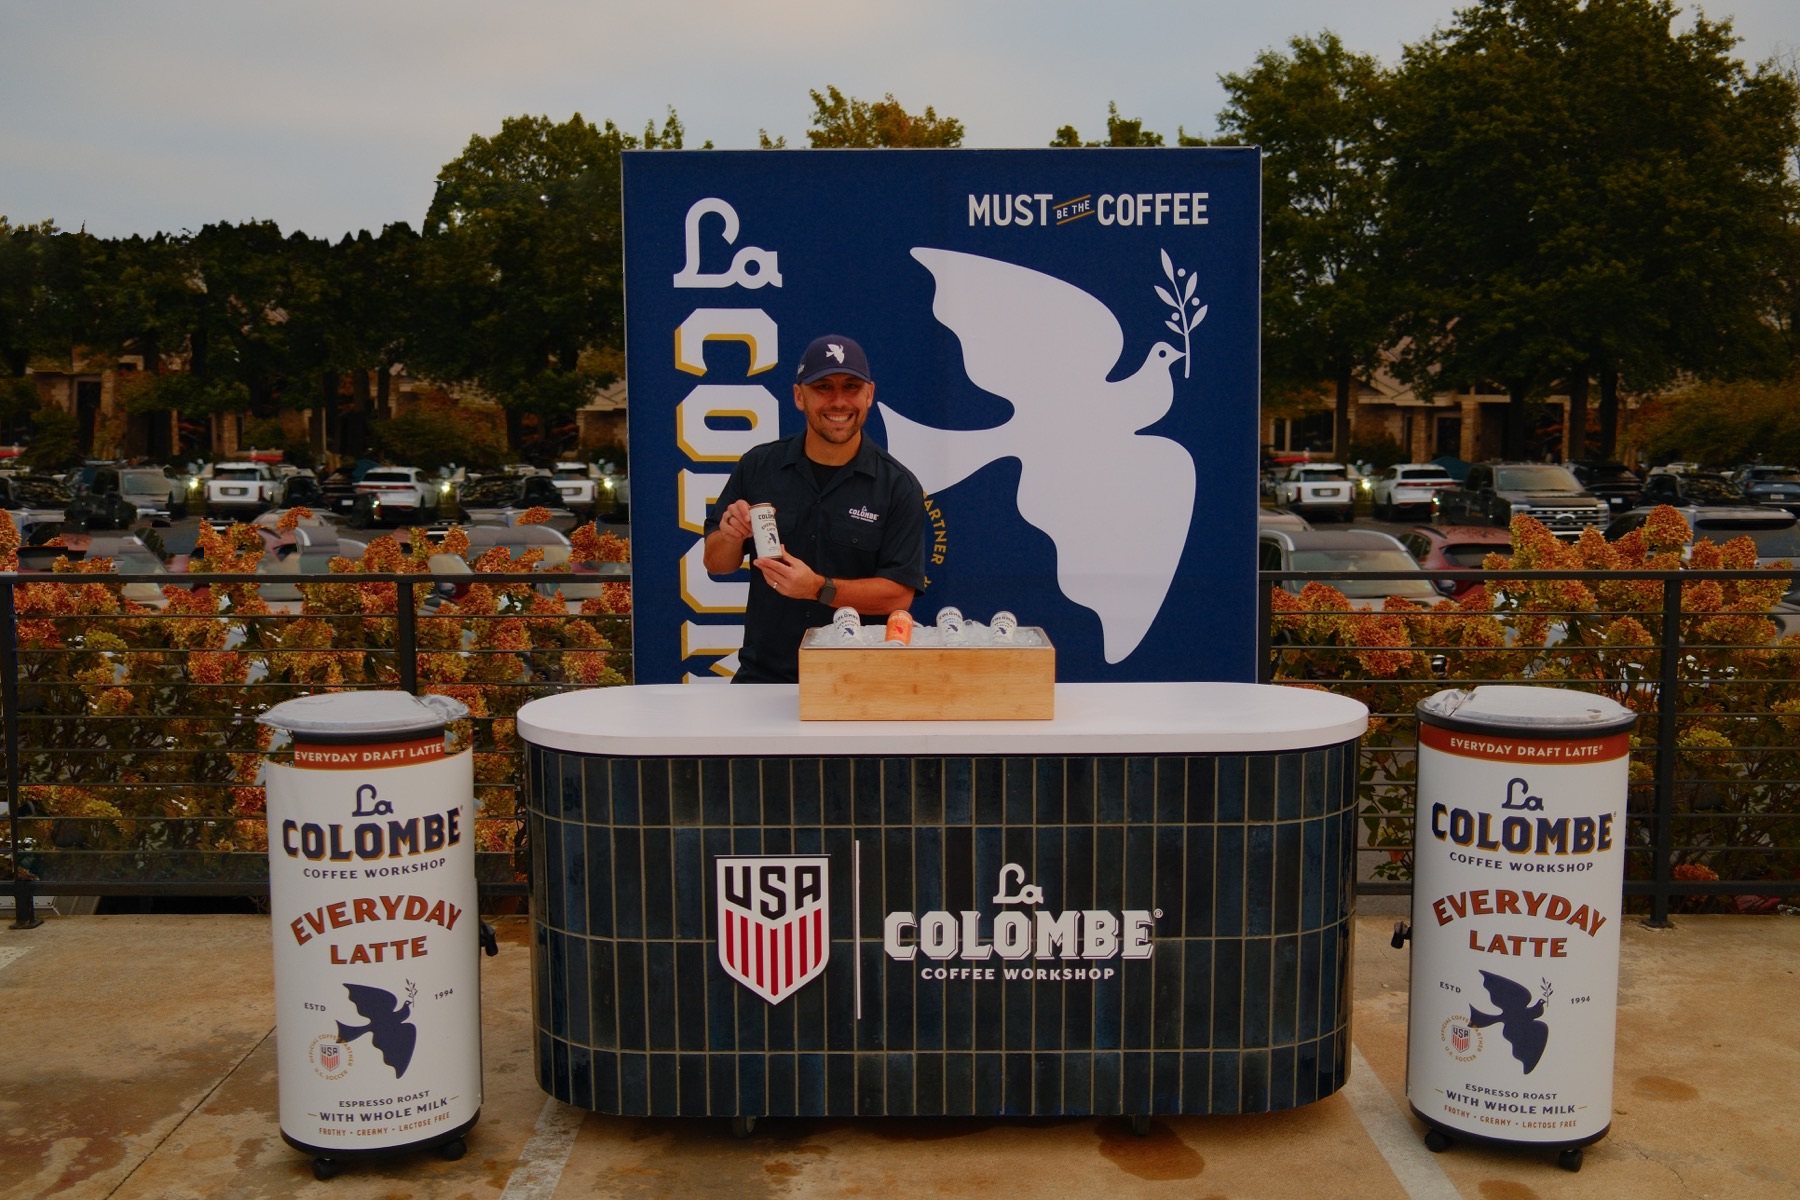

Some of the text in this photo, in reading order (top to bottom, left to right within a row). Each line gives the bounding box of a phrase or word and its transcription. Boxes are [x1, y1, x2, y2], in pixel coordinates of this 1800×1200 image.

[968, 192, 1209, 227] MUST BE THE COFFEE
[673, 197, 783, 290] La
[295, 751, 358, 763] EVERYDAY
[363, 749, 405, 762] DRAFT
[1450, 737, 1512, 755] EVERYDAY
[1517, 745, 1561, 757] DRAFT
[352, 784, 394, 817] La
[1501, 777, 1544, 812] La
[303, 857, 446, 880] COFFEE WORKSHOP
[1449, 851, 1594, 873] COFFEE WORKSHOP
[725, 865, 821, 921] USA
[993, 862, 1044, 905] La
[290, 894, 462, 946] EVERYDAY
[1432, 889, 1607, 937] EVERYDAY
[330, 935, 428, 965] LATTE
[1469, 929, 1568, 958] LATTE
[921, 968, 1115, 981] COFFEE WORKSHOP
[1439, 981, 1461, 993] ESTD
[434, 988, 454, 1000] 1994
[1570, 996, 1590, 1005] 1994
[304, 1002, 327, 1012] ESTD
[1453, 1027, 1469, 1039] USA
[321, 1046, 338, 1057] USA
[339, 1090, 430, 1108] ESPRESSO ROAST
[1446, 1089, 1576, 1115] WITH WHOLE MILK
[1465, 1083, 1557, 1100] ESPRESSO ROAST
[319, 1097, 448, 1122] WITH WHOLE MILK
[1444, 1104, 1577, 1129] FROTHY CREAMY LACTOSE FREE
[319, 1111, 451, 1136] FROTHY CREAMY LACTOSE FREE
